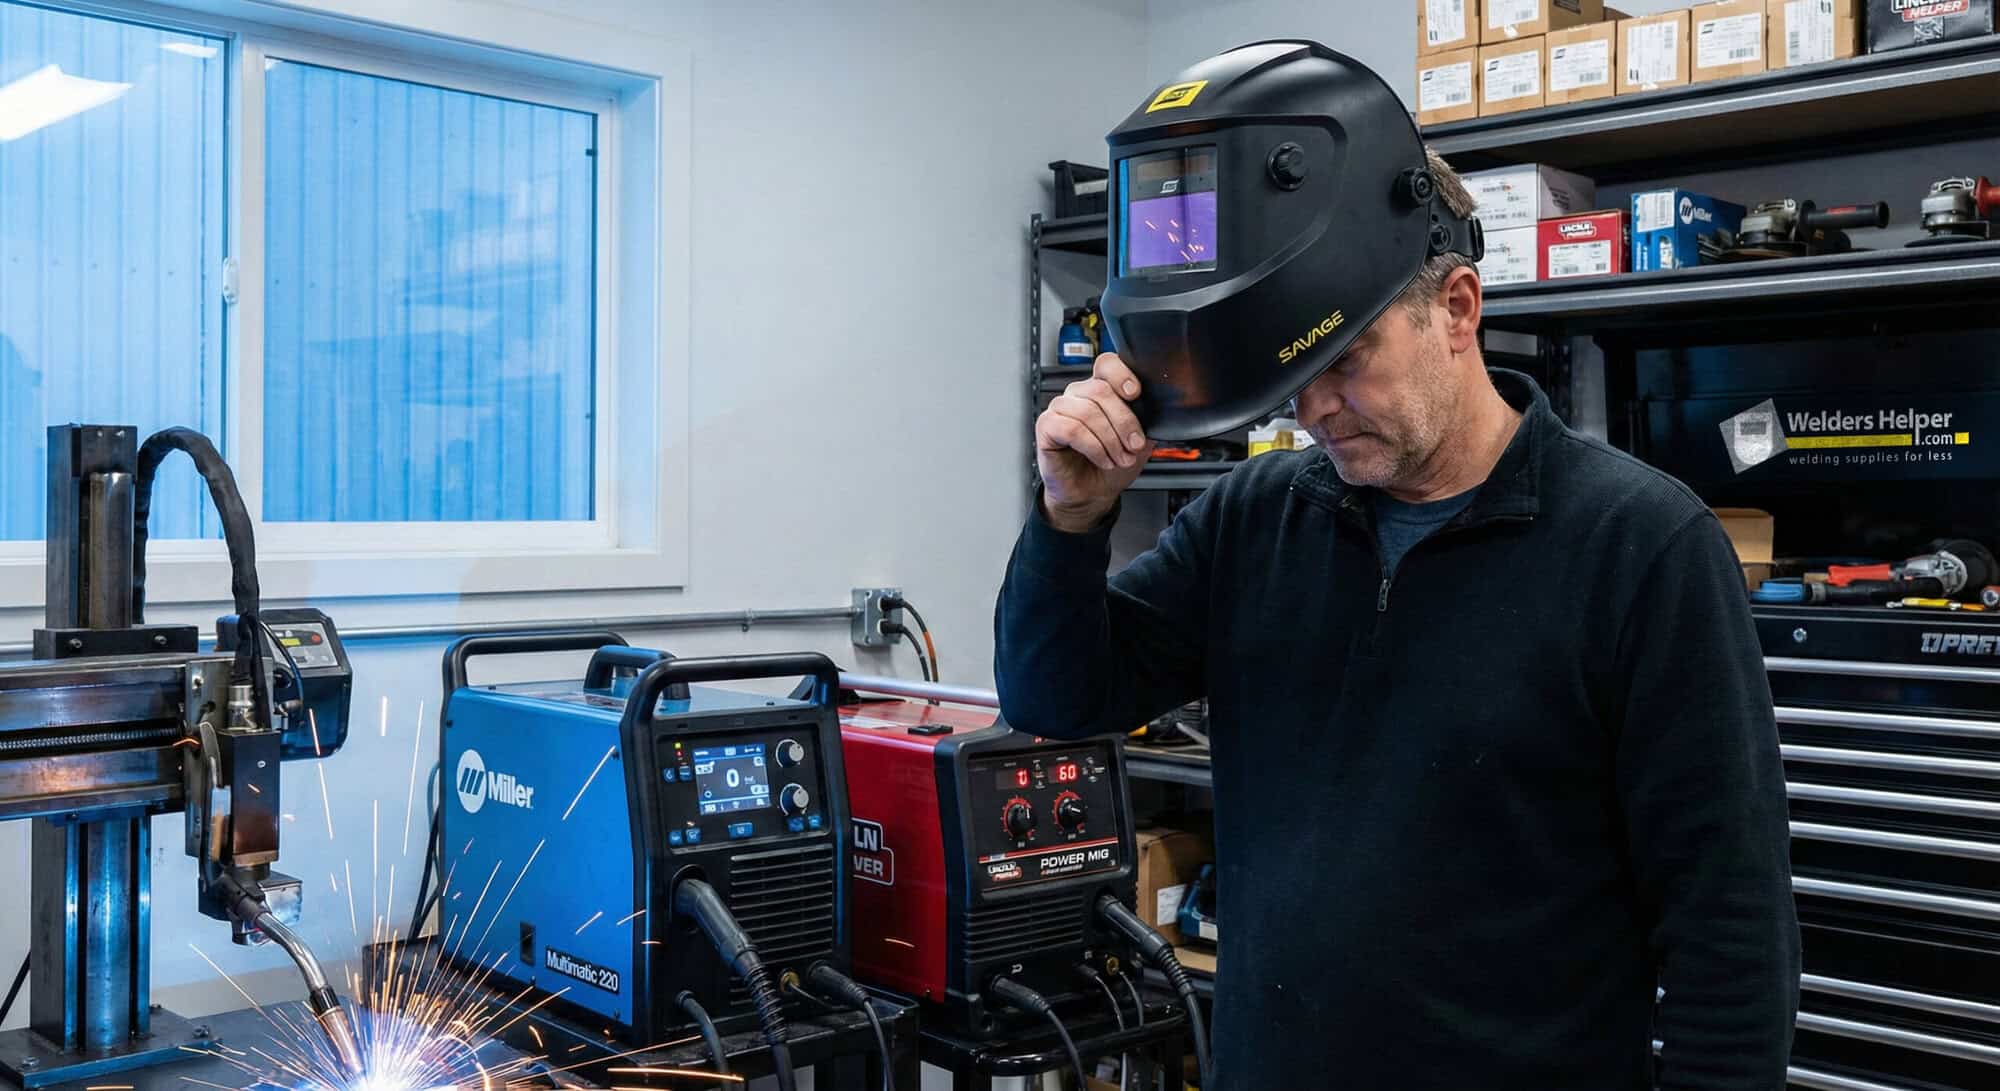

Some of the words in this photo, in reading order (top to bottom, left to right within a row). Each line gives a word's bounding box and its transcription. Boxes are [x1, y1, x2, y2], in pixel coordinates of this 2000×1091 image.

[1911, 1, 1961, 18] HELPER
[1279, 310, 1344, 364] SAVAGE
[1787, 410, 1874, 432] Welders
[1879, 408, 1952, 446] Helper
[1921, 433, 1953, 445] .com
[1789, 453, 1840, 466] welding
[1846, 452, 1899, 464] supplies
[1905, 451, 1923, 462] for
[1928, 450, 1953, 461] less
[726, 768, 740, 788] 0
[1059, 764, 1077, 781] 60
[488, 771, 533, 808] Miller
[854, 825, 877, 851] LN
[853, 855, 883, 876] VER
[1040, 852, 1085, 869] POWER
[1088, 849, 1109, 861] MIG
[547, 950, 598, 983] Multimatic
[600, 969, 618, 992] 220
